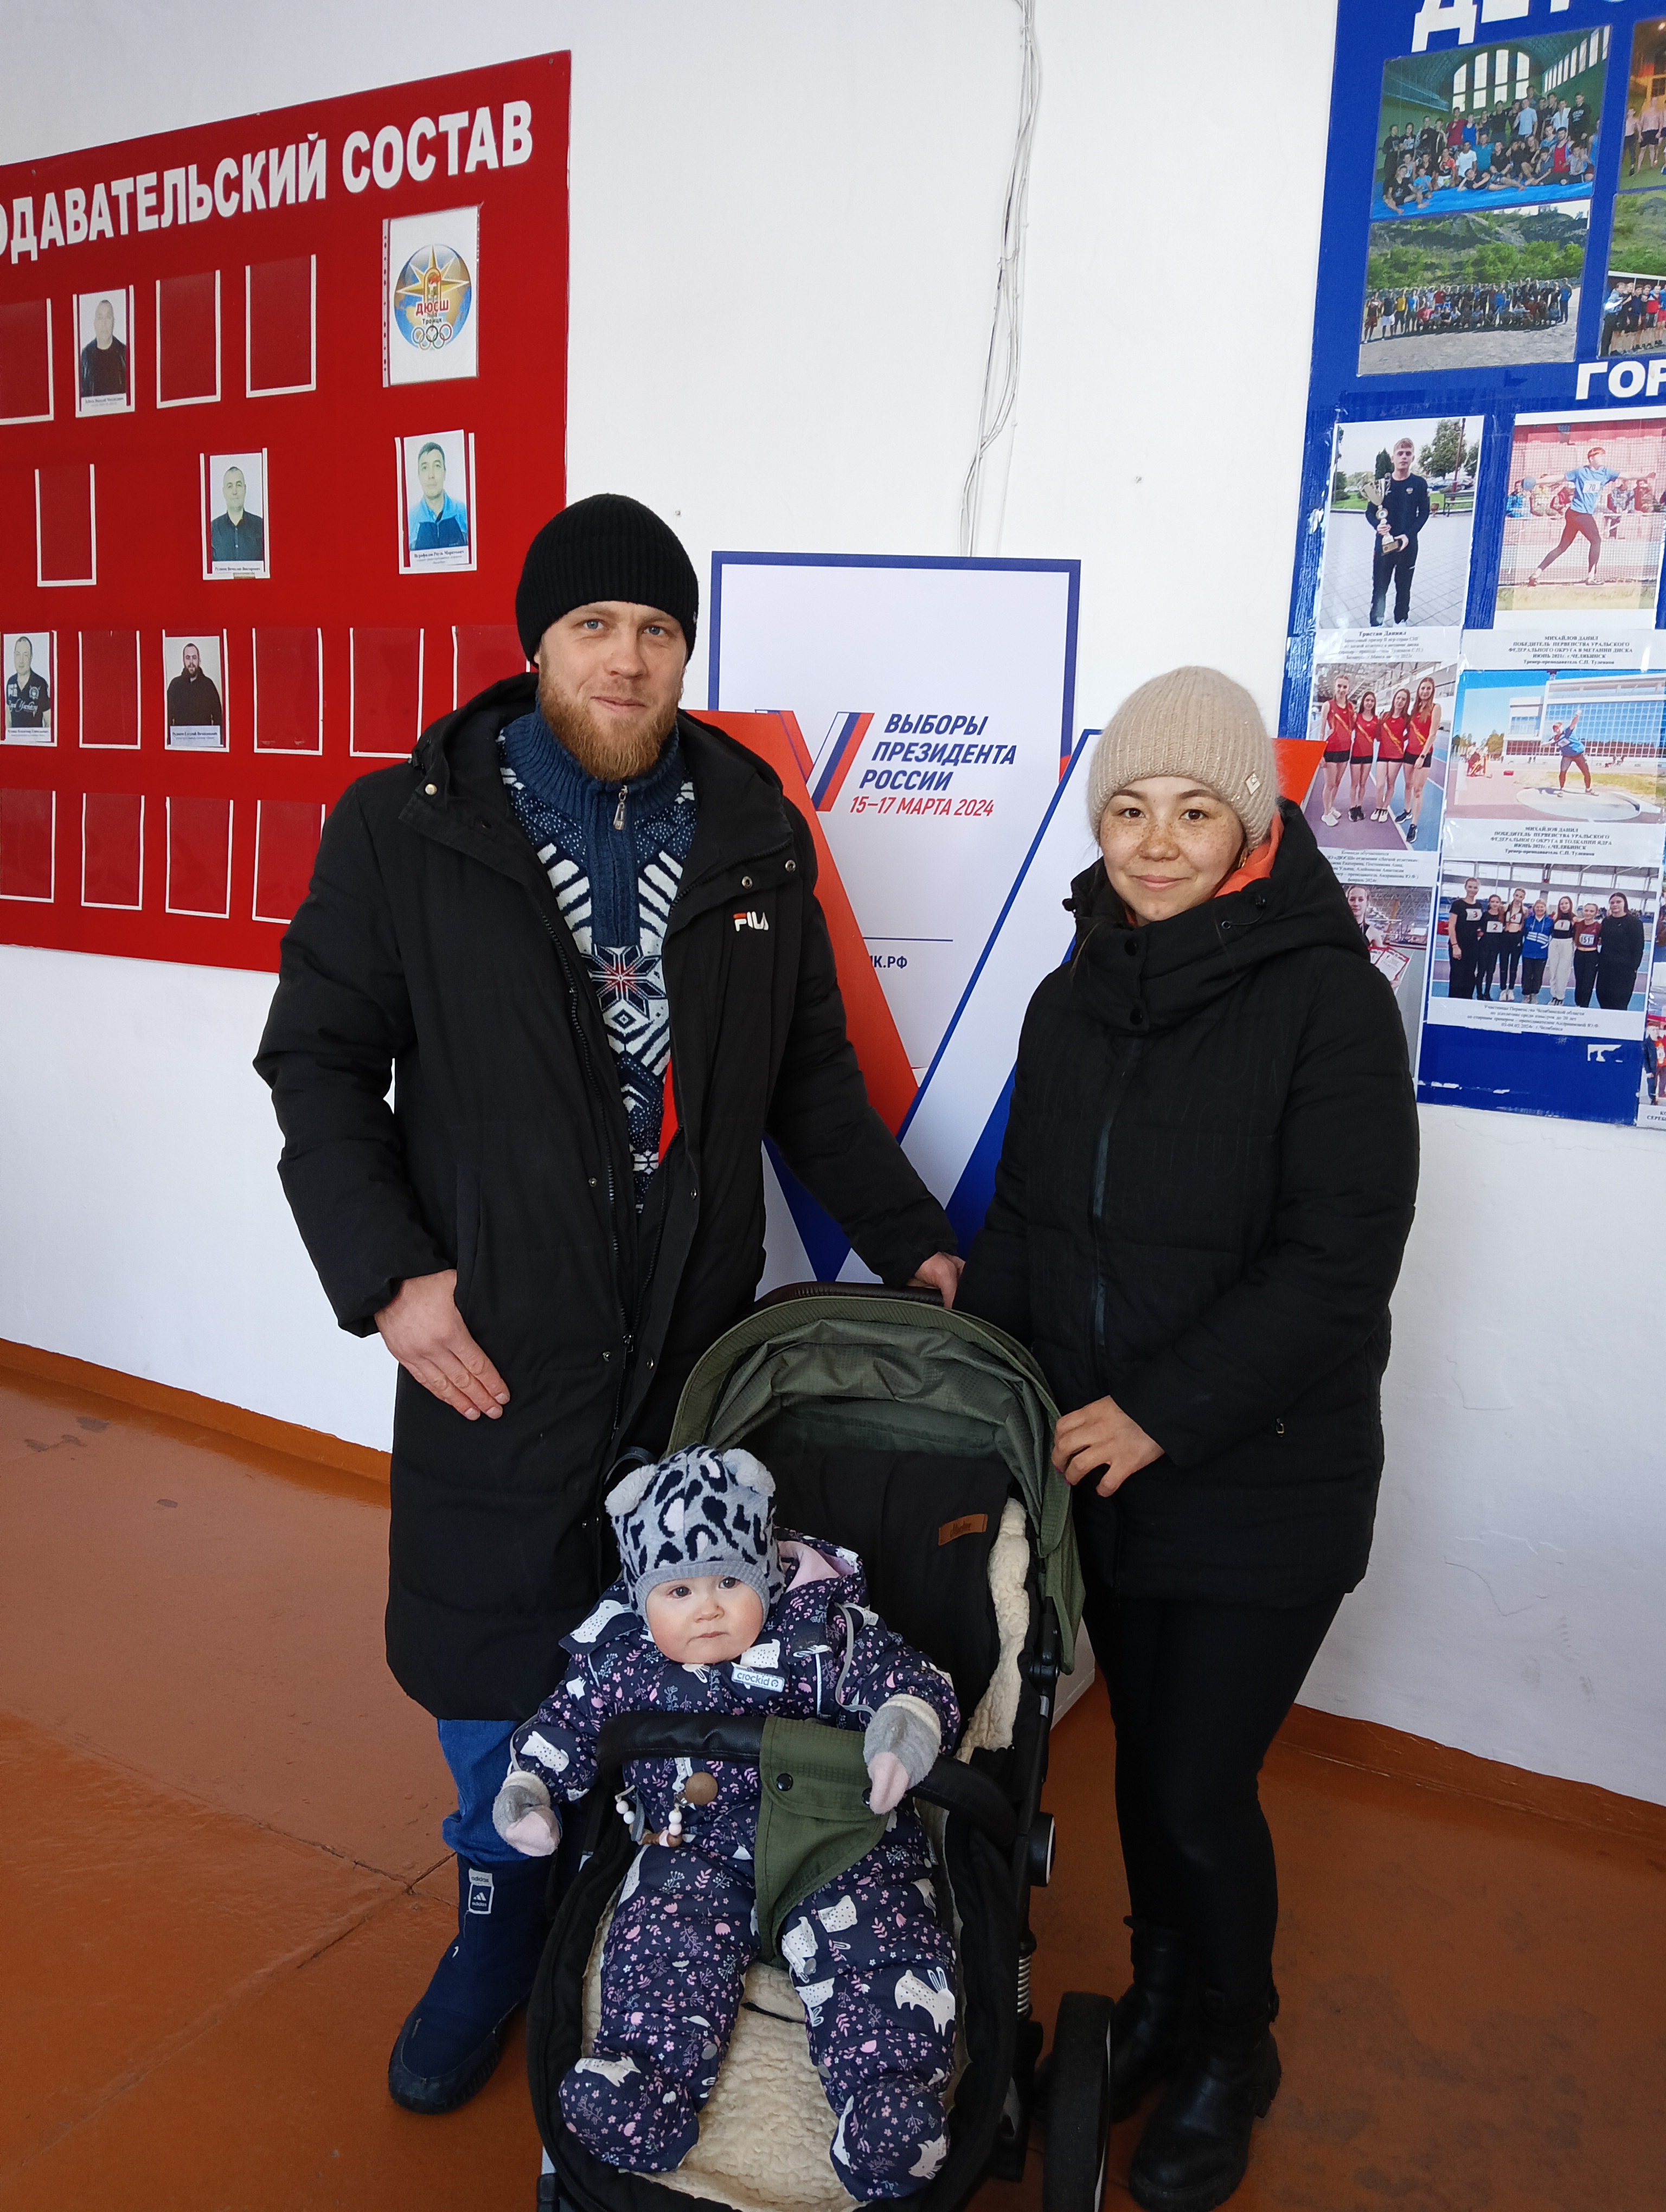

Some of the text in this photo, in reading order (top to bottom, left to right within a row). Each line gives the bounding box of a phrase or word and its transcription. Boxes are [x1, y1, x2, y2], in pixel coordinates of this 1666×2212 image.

[342, 100, 533, 194] СОСТАВ
[415, 299, 449, 317] ДЮСШ
[884, 713, 989, 735] ВЫБОРЫ
[871, 741, 1017, 767] ПРЕЗИДЕНТА
[858, 769, 954, 791] РОССИИ
[896, 797, 953, 815] МАРТА
[953, 799, 994, 816] 2024
[733, 911, 769, 932] FILA
[1472, 910, 1478, 918] 3
[736, 1672, 770, 1686] crockid
